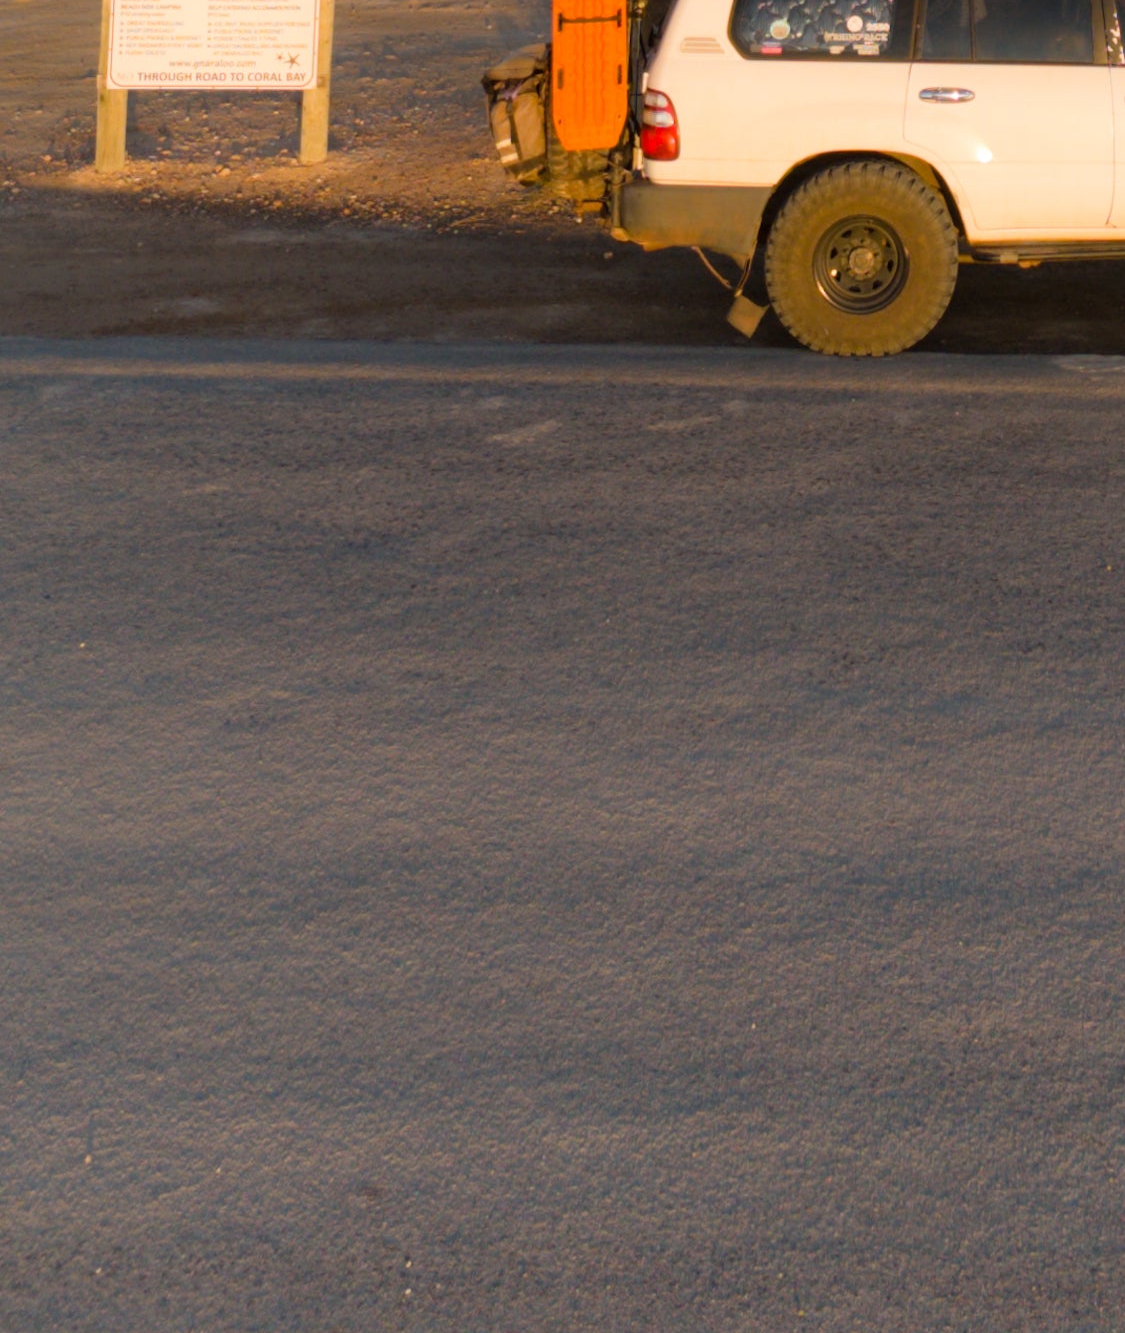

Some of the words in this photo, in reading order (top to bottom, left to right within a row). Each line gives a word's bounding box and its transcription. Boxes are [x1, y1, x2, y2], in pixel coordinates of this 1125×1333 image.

[137, 72, 193, 81] THROUGH
[195, 72, 227, 81] ROAD
[231, 72, 243, 81] TO
[247, 72, 282, 81] CORAL
[286, 72, 307, 81] BAY
